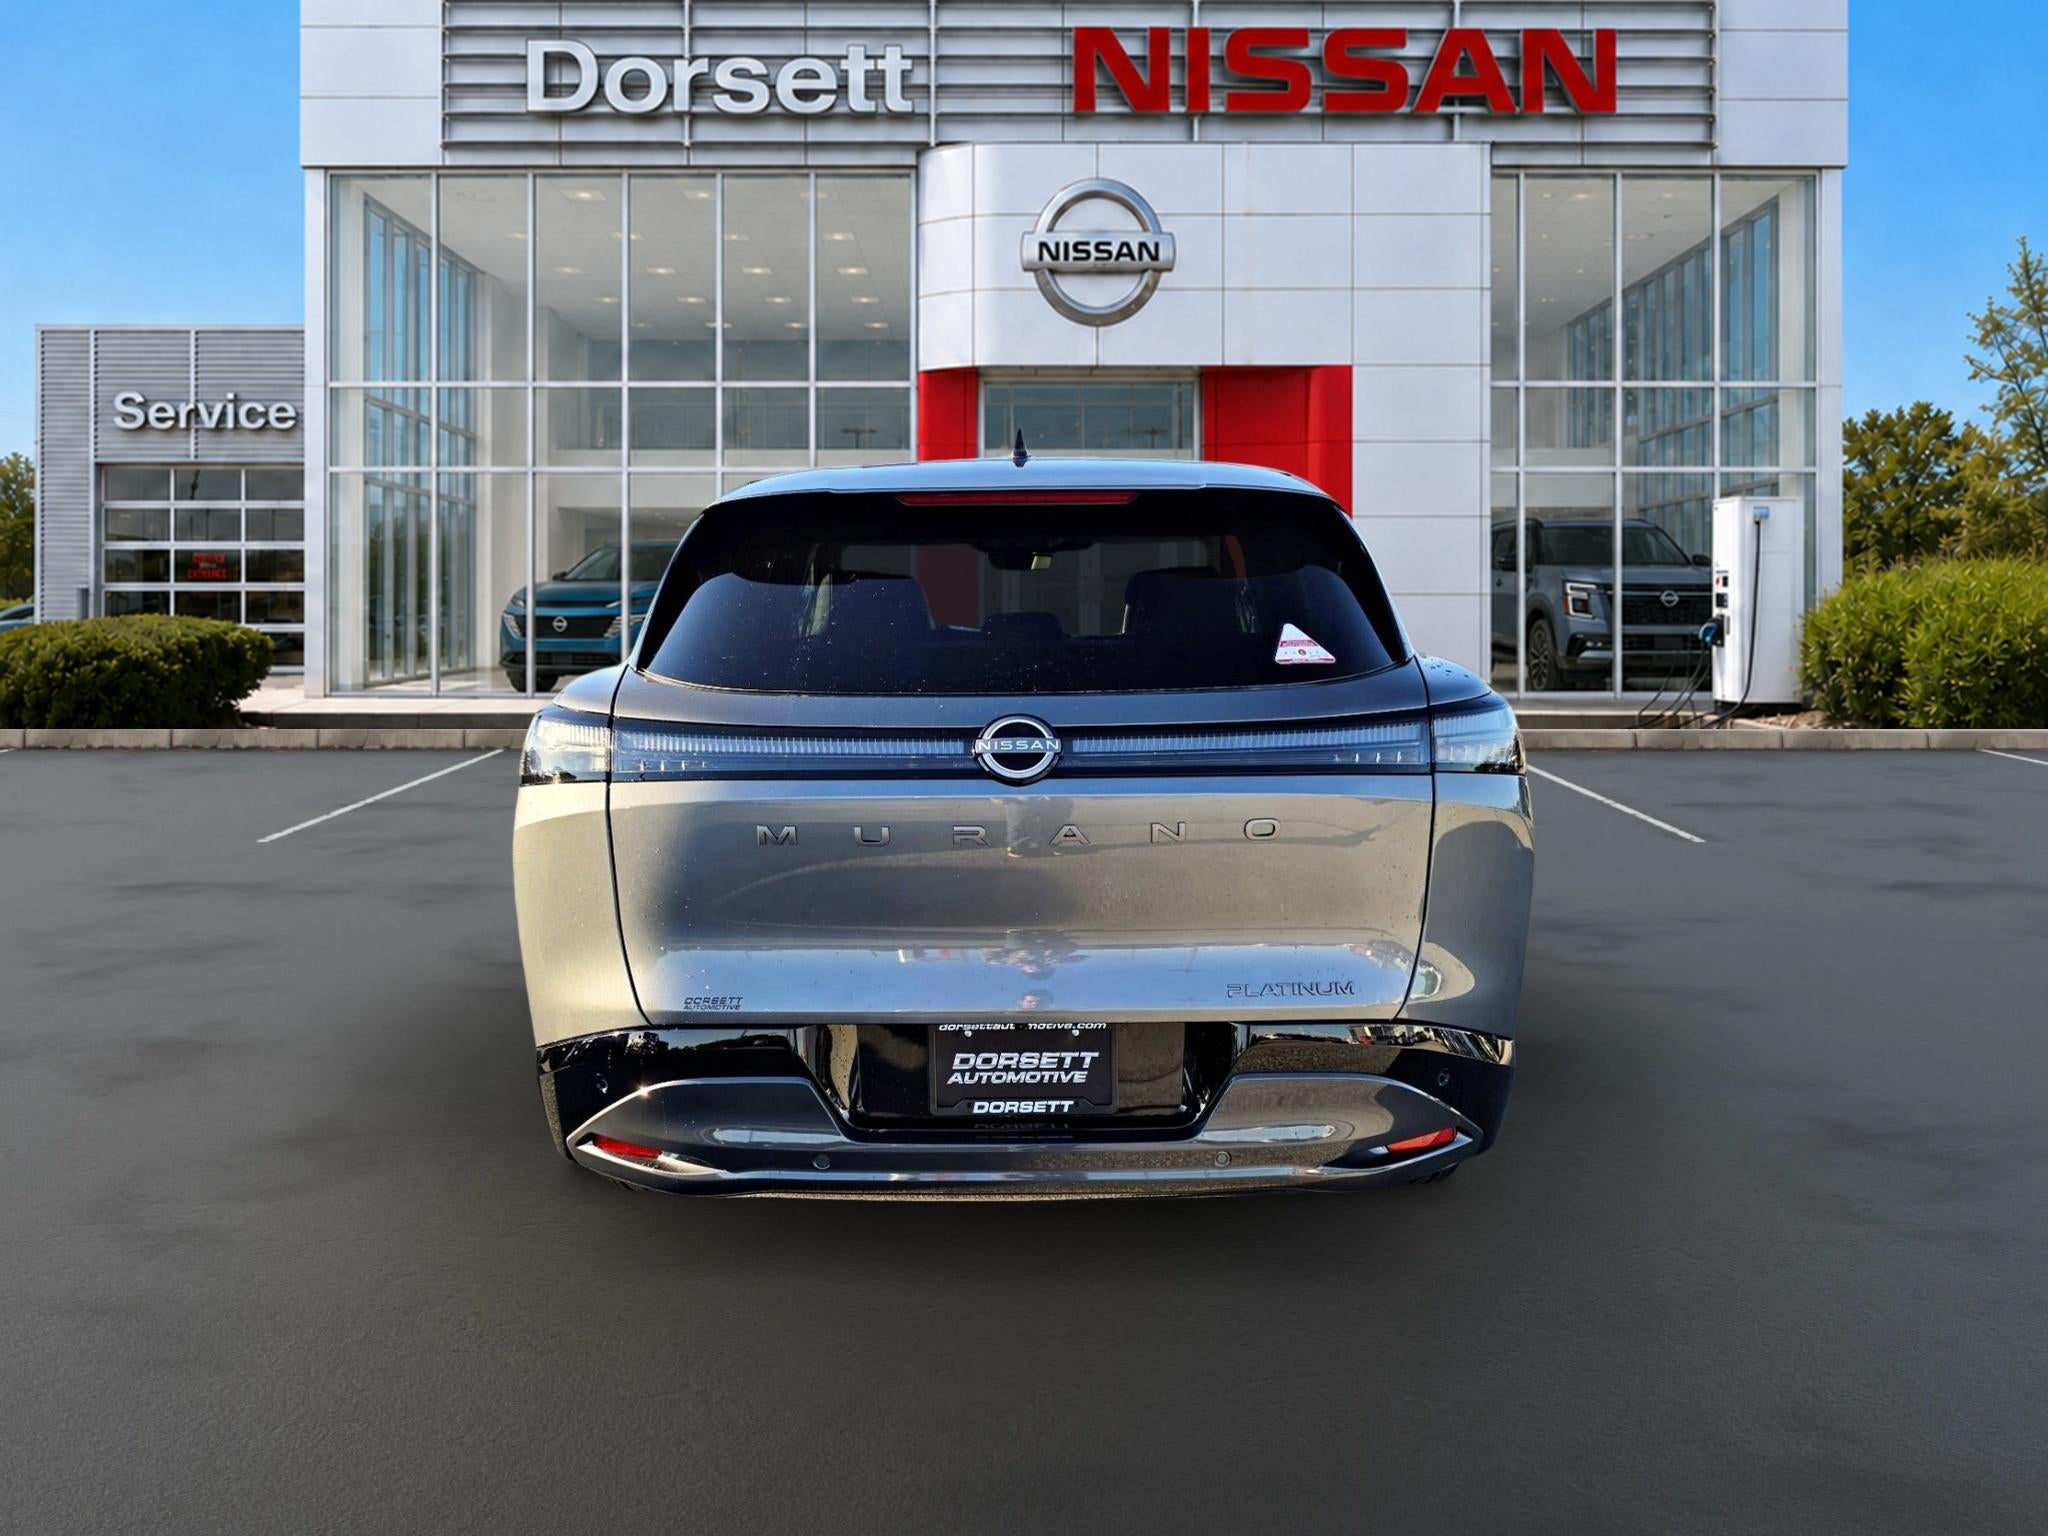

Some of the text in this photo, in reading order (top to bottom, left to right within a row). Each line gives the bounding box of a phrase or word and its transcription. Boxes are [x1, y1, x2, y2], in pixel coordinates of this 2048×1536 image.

[526, 39, 913, 114] Dorsett
[1073, 27, 1617, 113] NISSAN
[1037, 240, 1160, 262] NISSAN
[112, 390, 298, 431] Service
[978, 739, 1060, 751] NISSAN
[755, 817, 1284, 848] MURANO
[1226, 980, 1356, 999] PLATINUM
[683, 996, 744, 1005] DORSETT
[952, 1051, 1100, 1070] DORSETT
[946, 1070, 1089, 1085] AUTOMOTIVE
[972, 1100, 1075, 1114] DORSETT
